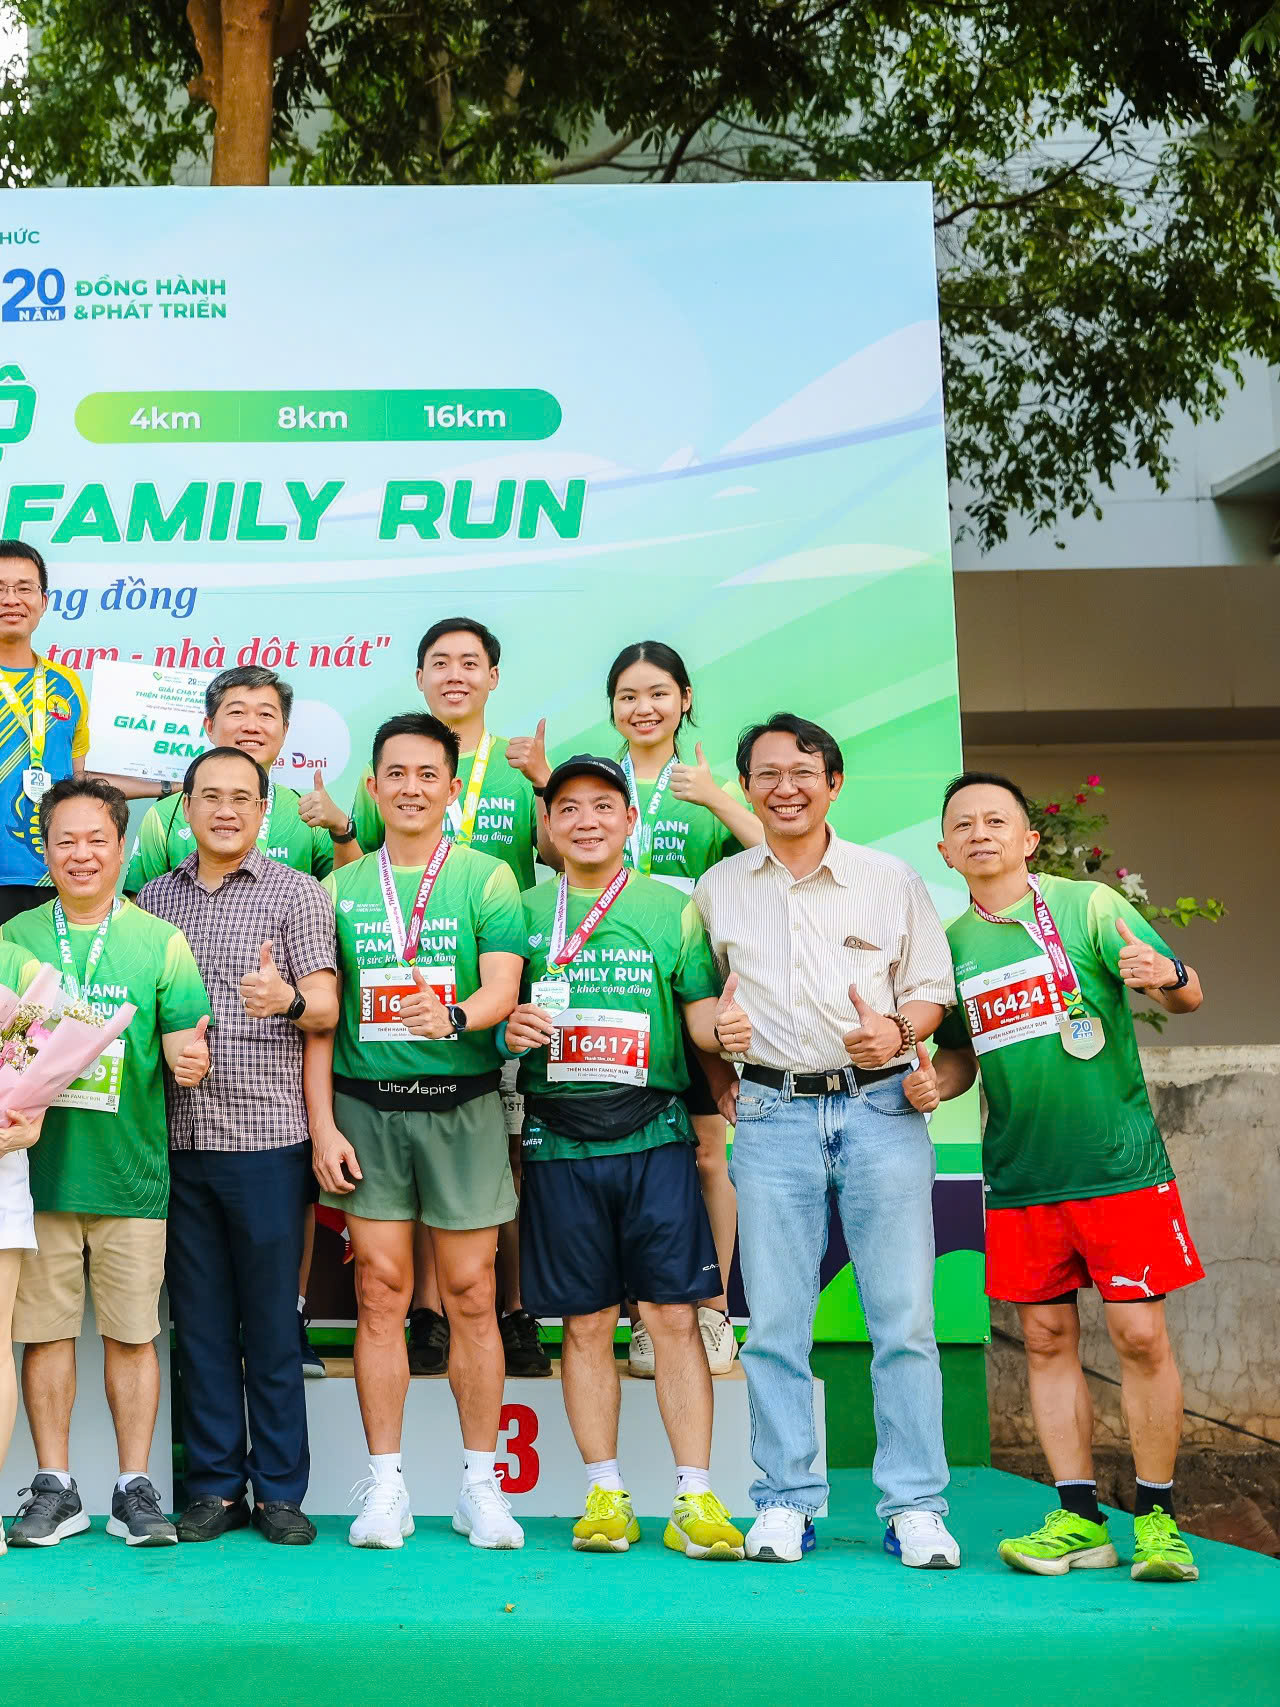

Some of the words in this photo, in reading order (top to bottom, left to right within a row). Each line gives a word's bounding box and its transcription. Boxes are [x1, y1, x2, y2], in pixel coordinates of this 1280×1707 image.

[2, 268, 66, 312] 20
[74, 274, 148, 298] ĐỒNG
[155, 274, 227, 298] HÀNH
[18, 307, 61, 321] NĂM
[158, 294, 228, 320] TRIỂN
[129, 406, 202, 430] 4km
[278, 405, 348, 430] 8km
[424, 403, 507, 429] 16km
[1, 480, 346, 545] FAMILY
[377, 478, 587, 541] RUN
[100, 575, 198, 619] đồng
[155, 636, 226, 669] nhà
[310, 636, 392, 668] nát"
[113, 714, 156, 732] GIẢI
[163, 723, 190, 737] BA
[153, 740, 205, 758] 8KM
[291, 752, 327, 769] Dani
[477, 815, 513, 831] RUN
[416, 878, 434, 908] 16KM
[581, 907, 603, 934] 16KM
[1036, 904, 1056, 937] 16KM
[421, 936, 457, 952] RUN
[601, 949, 654, 965] HẠNH
[614, 968, 653, 983] RUN
[362, 988, 372, 1021] 16KM
[982, 986, 1046, 1019] 16424
[967, 999, 980, 1035] 16KM
[550, 1028, 561, 1061] 16KM
[568, 1035, 634, 1055] 16417
[495, 1403, 540, 1494] 3
